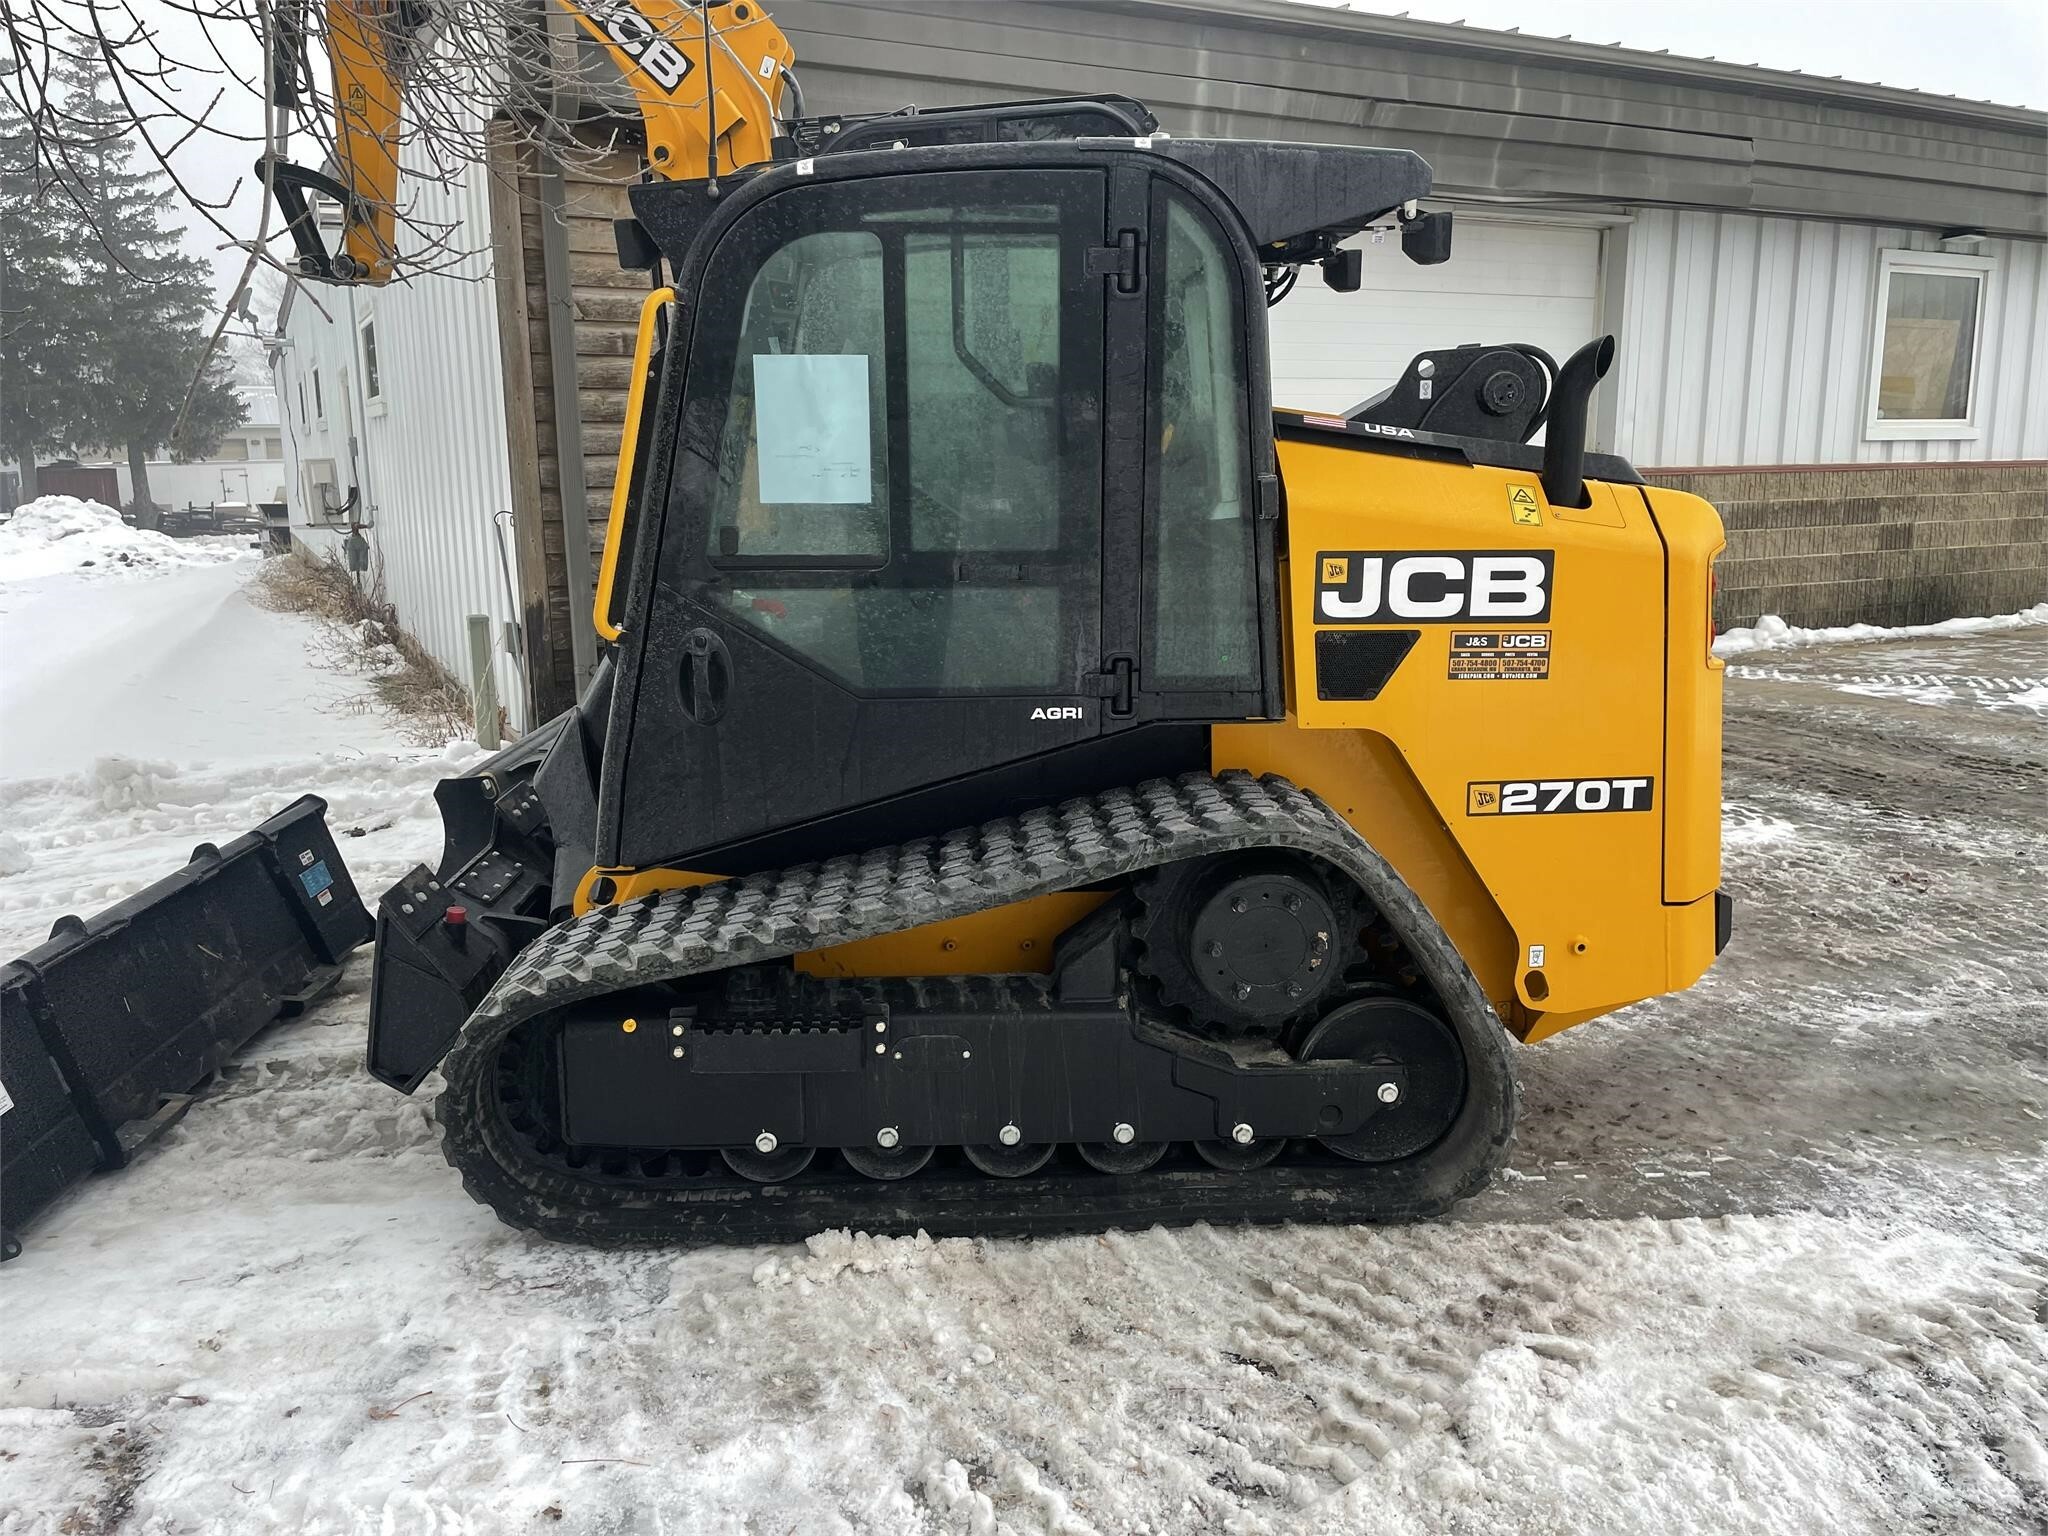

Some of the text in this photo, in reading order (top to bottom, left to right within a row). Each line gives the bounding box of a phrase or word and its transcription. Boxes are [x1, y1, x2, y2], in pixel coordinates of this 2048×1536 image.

[1364, 423, 1415, 438] USA
[1320, 556, 1545, 618] JCB
[1466, 637, 1488, 646] J&S
[1503, 636, 1546, 647] JCB
[1030, 707, 1083, 720] AGRI
[1477, 779, 1647, 813] JCB 270T
